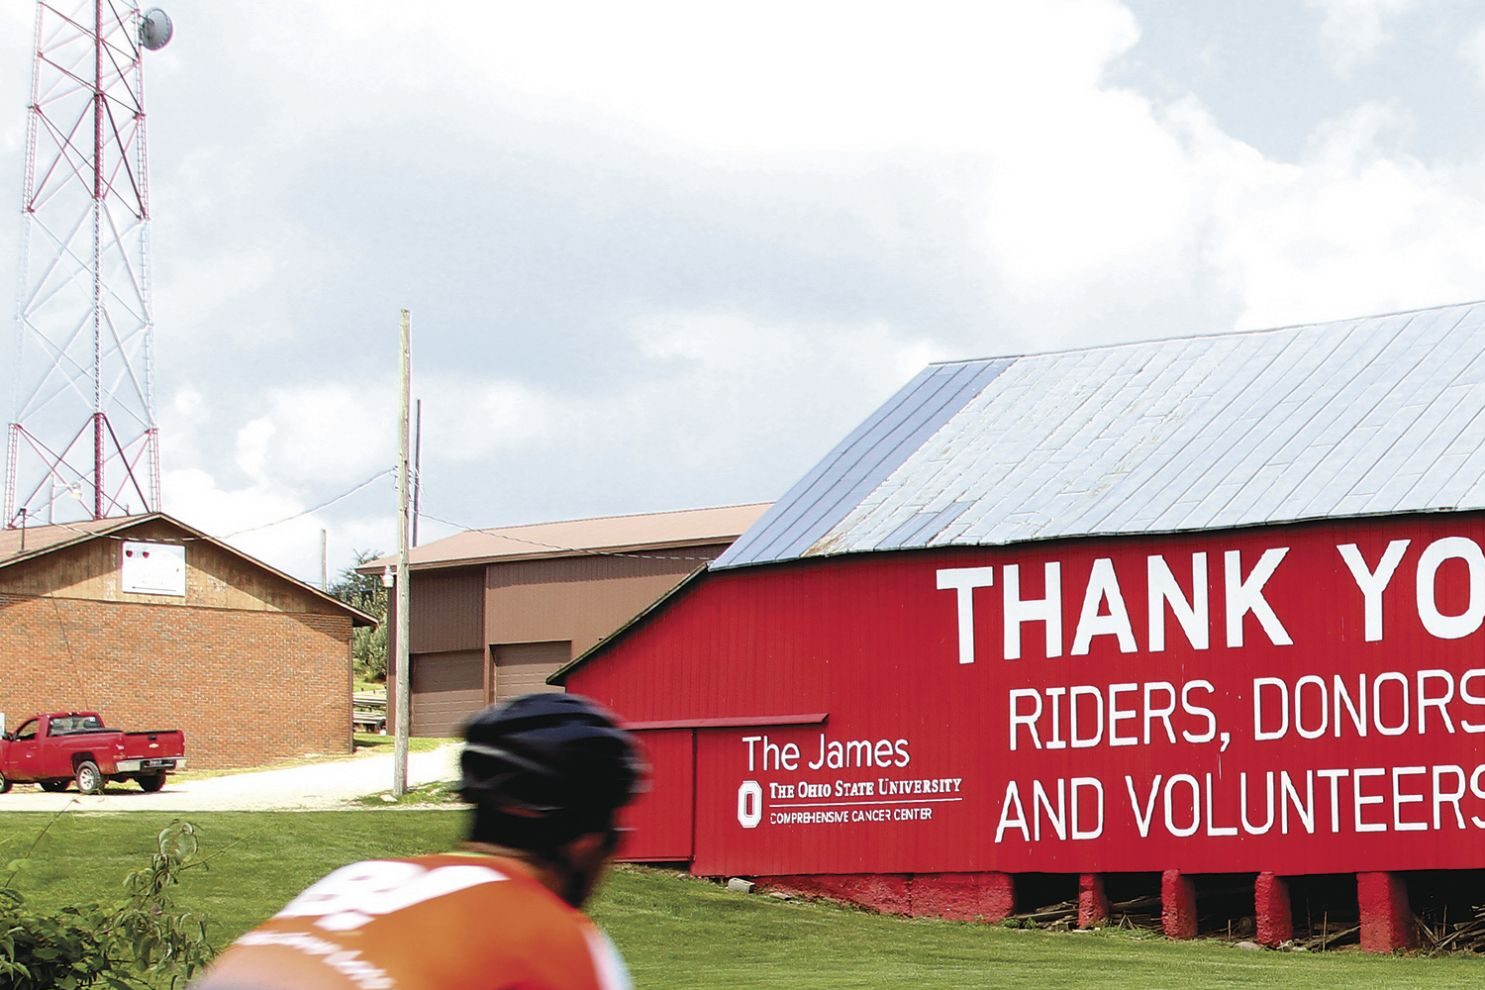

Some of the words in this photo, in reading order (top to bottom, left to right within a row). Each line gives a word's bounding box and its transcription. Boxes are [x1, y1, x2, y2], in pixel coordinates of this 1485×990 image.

[935, 546, 1293, 665] THANK
[1009, 679, 1230, 753] RIDERS,
[741, 735, 800, 772] The
[808, 733, 910, 770] James
[769, 782, 795, 799] THE
[797, 781, 832, 799] OHIO
[834, 779, 875, 797] STATE
[877, 778, 962, 796] UNIVERSITY
[994, 776, 1104, 844] AND
[769, 808, 849, 825] COMPREHENSIVE
[851, 809, 891, 823] CANCER
[893, 807, 933, 821] CENTER
